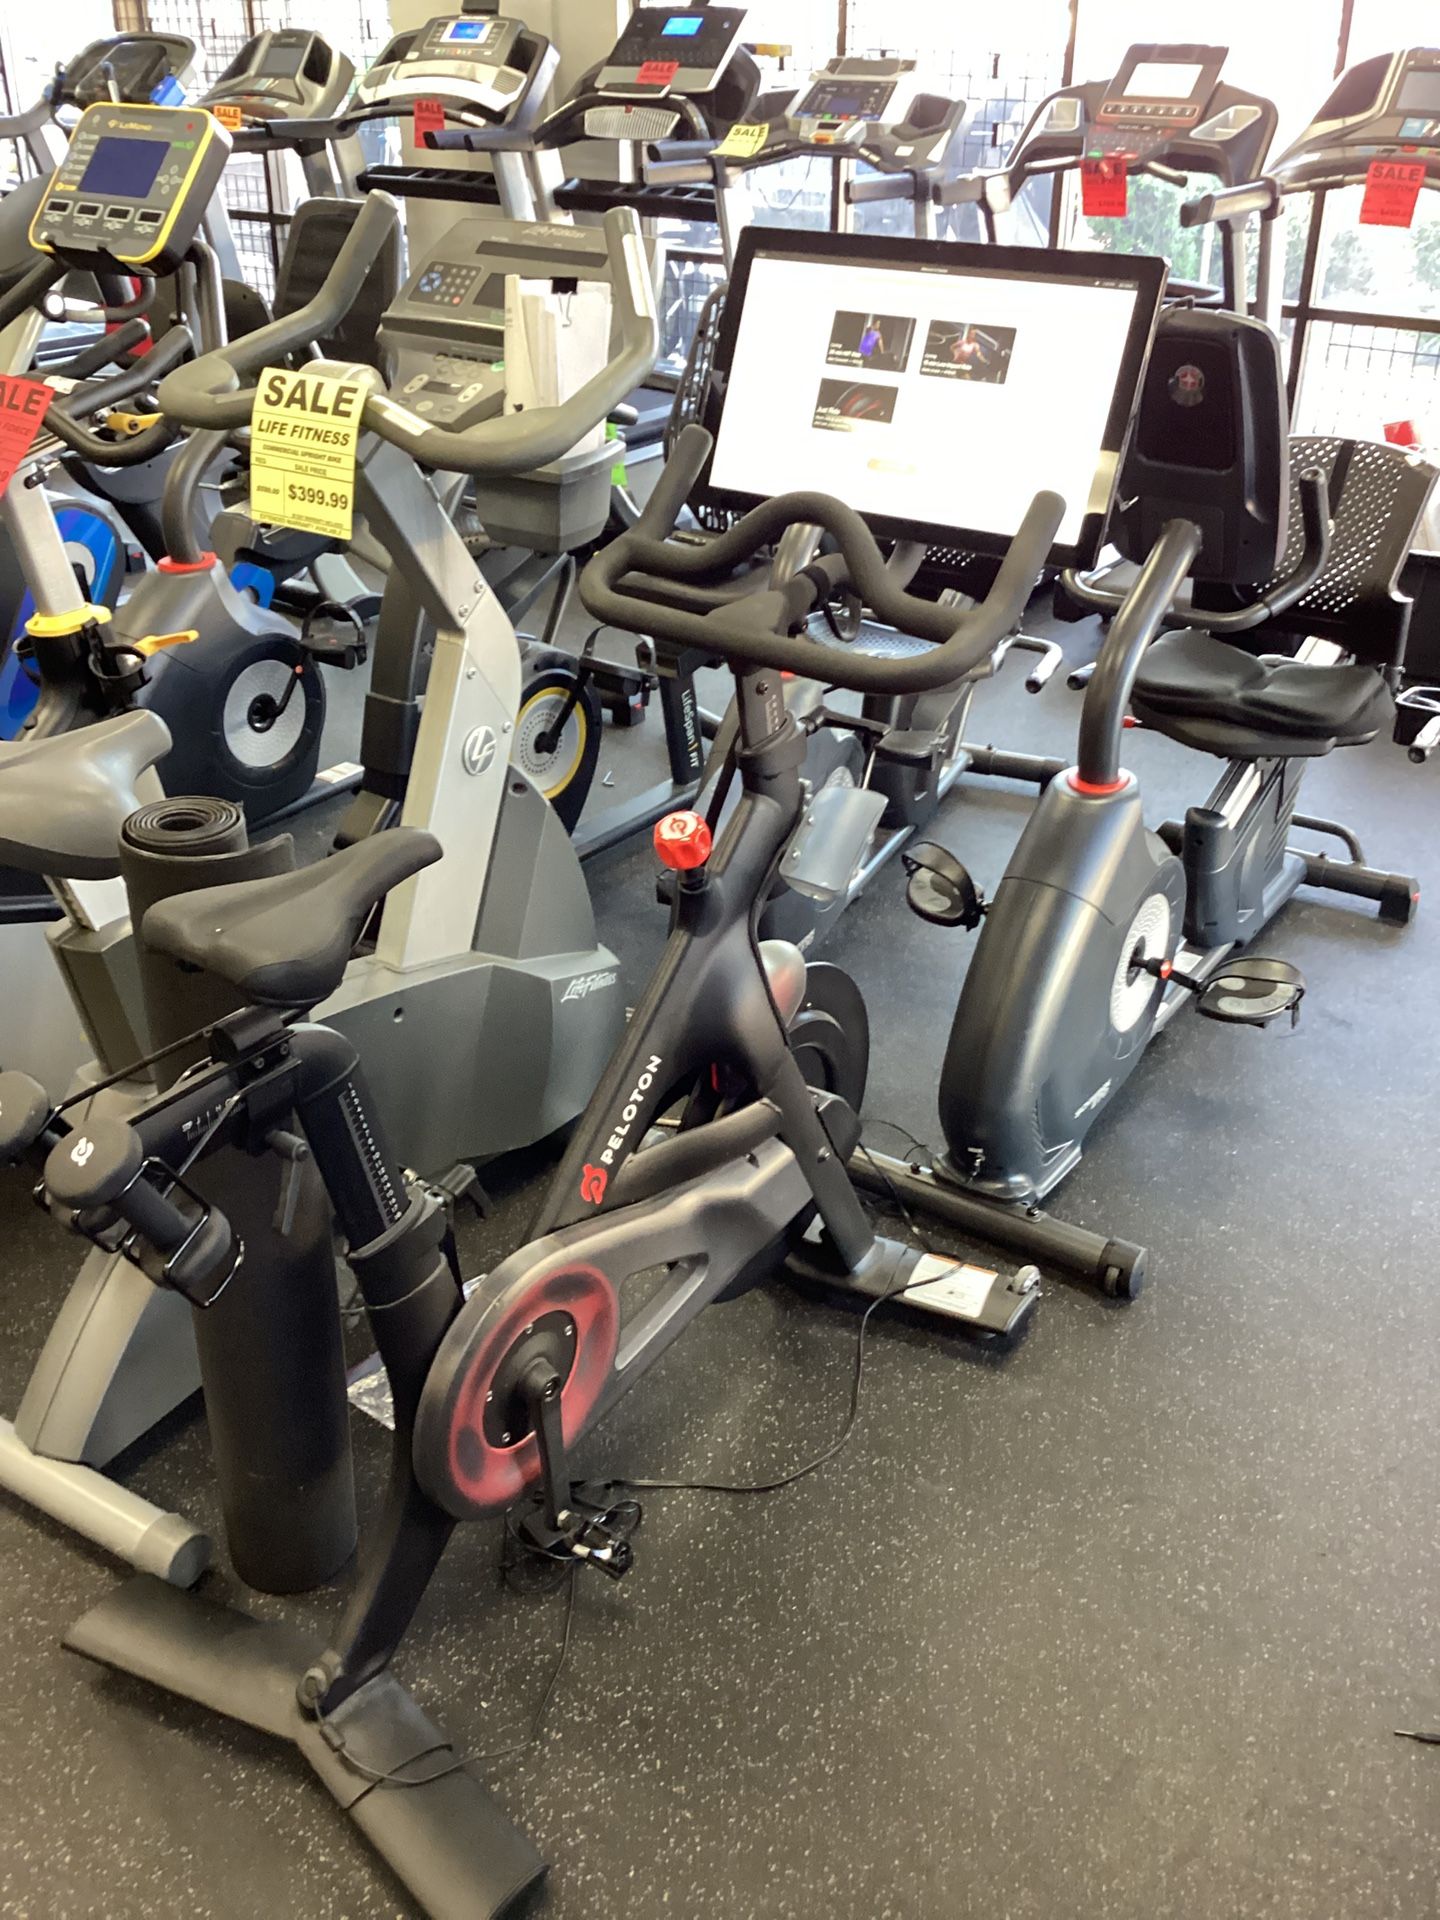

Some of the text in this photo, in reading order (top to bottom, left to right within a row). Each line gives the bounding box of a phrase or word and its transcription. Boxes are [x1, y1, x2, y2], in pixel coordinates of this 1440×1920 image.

[216, 107, 239, 119] SALE
[416, 102, 443, 115] SALE
[733, 126, 766, 138] SALE
[1372, 164, 1422, 183] SALE
[263, 375, 359, 419] SALE
[257, 419, 351, 447] LIFE FITNESS
[288, 484, 349, 511] $399.99
[600, 1054, 662, 1166] PELOTON
